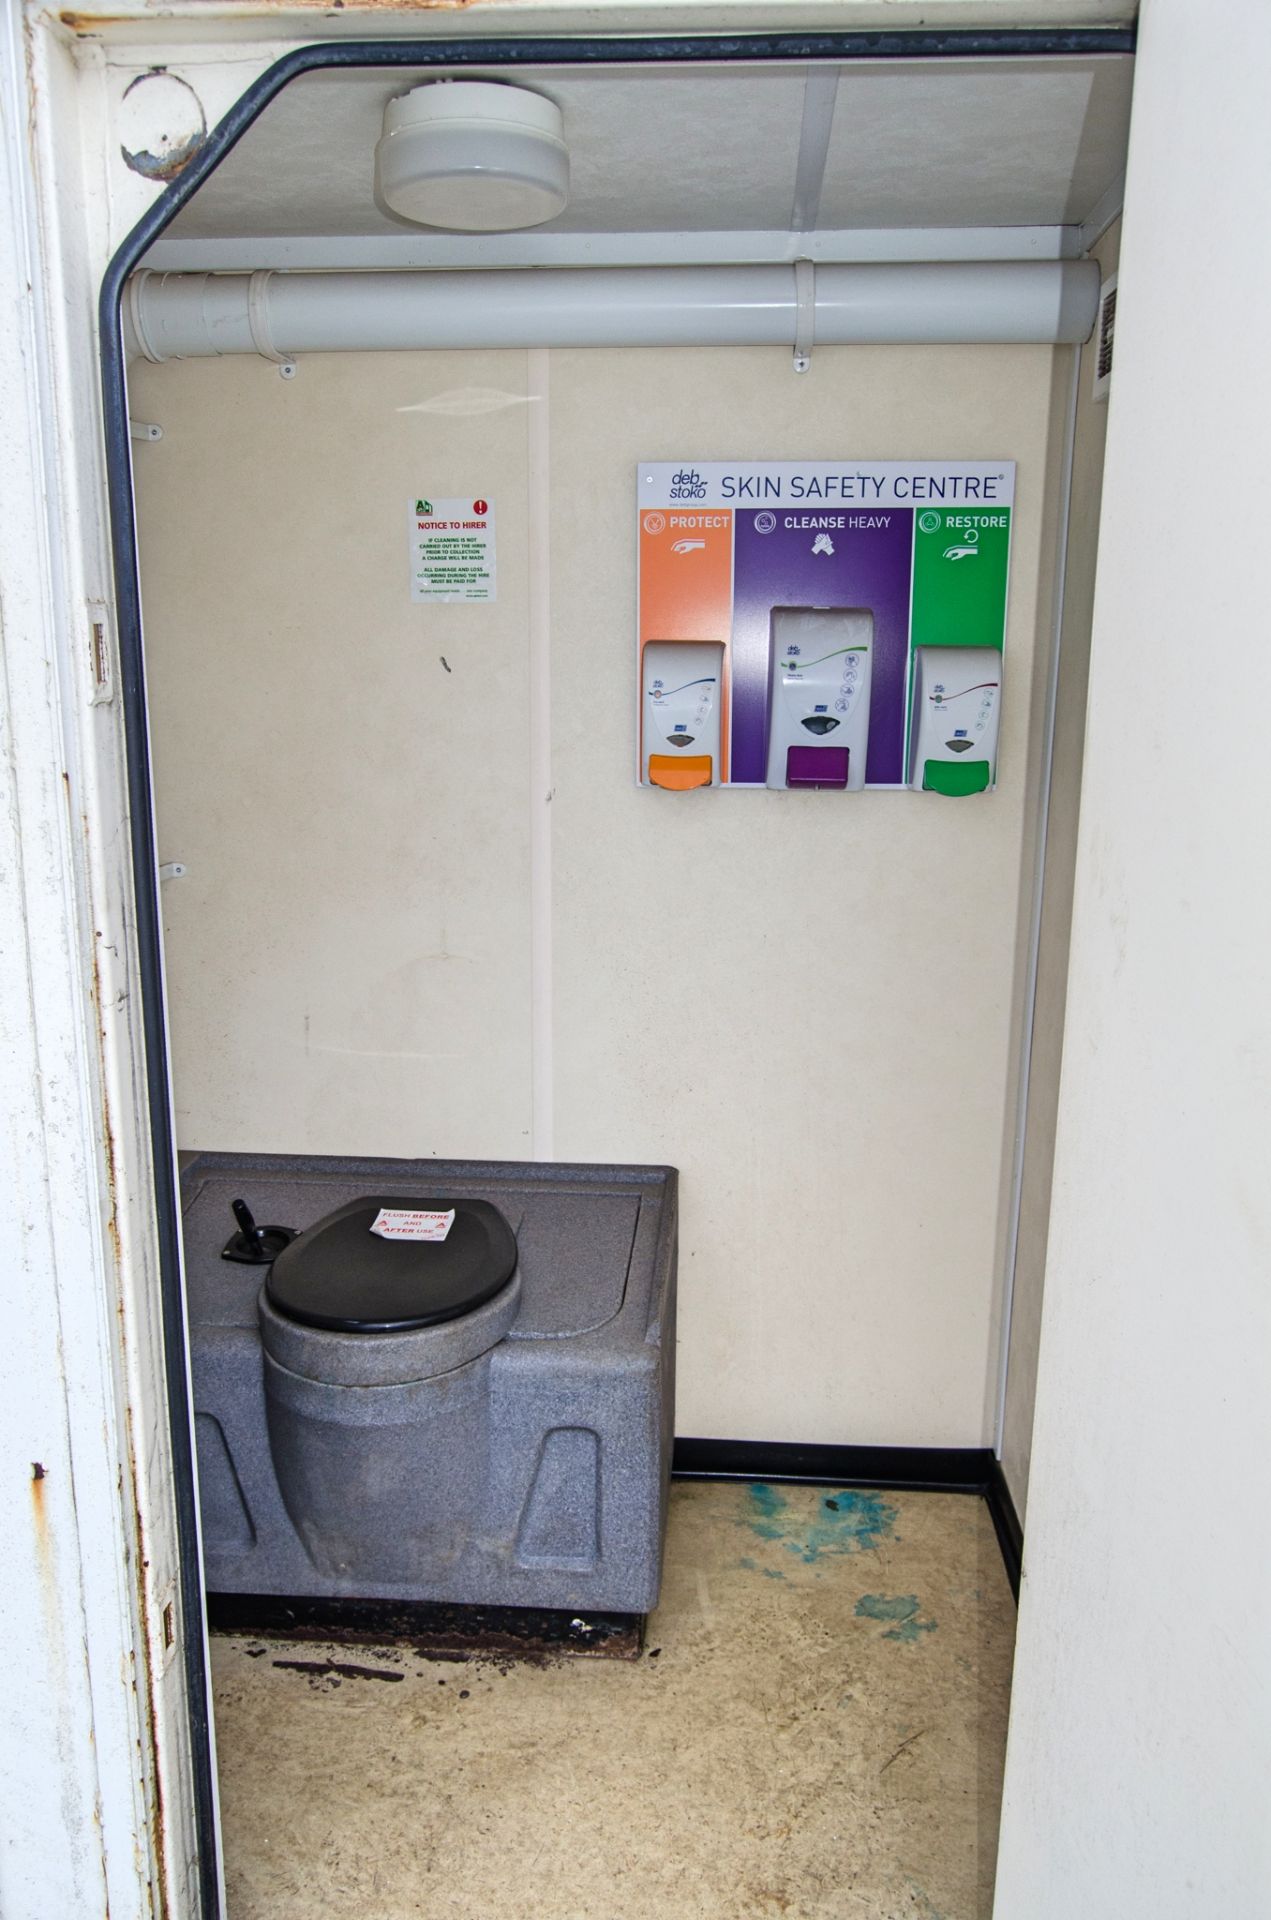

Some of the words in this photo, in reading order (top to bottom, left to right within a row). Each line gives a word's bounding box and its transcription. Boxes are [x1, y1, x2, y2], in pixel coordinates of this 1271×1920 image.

[672, 469, 700, 485] deb
[721, 476, 781, 498] SKIN
[790, 476, 886, 498] SAFETY
[418, 522, 448, 530] NOTICE
[462, 521, 487, 529] HIRER
[670, 516, 730, 528] PROTECT
[784, 516, 846, 529] CLEANSE
[849, 516, 891, 529] HEAVY
[946, 516, 1007, 528] RESTORE
